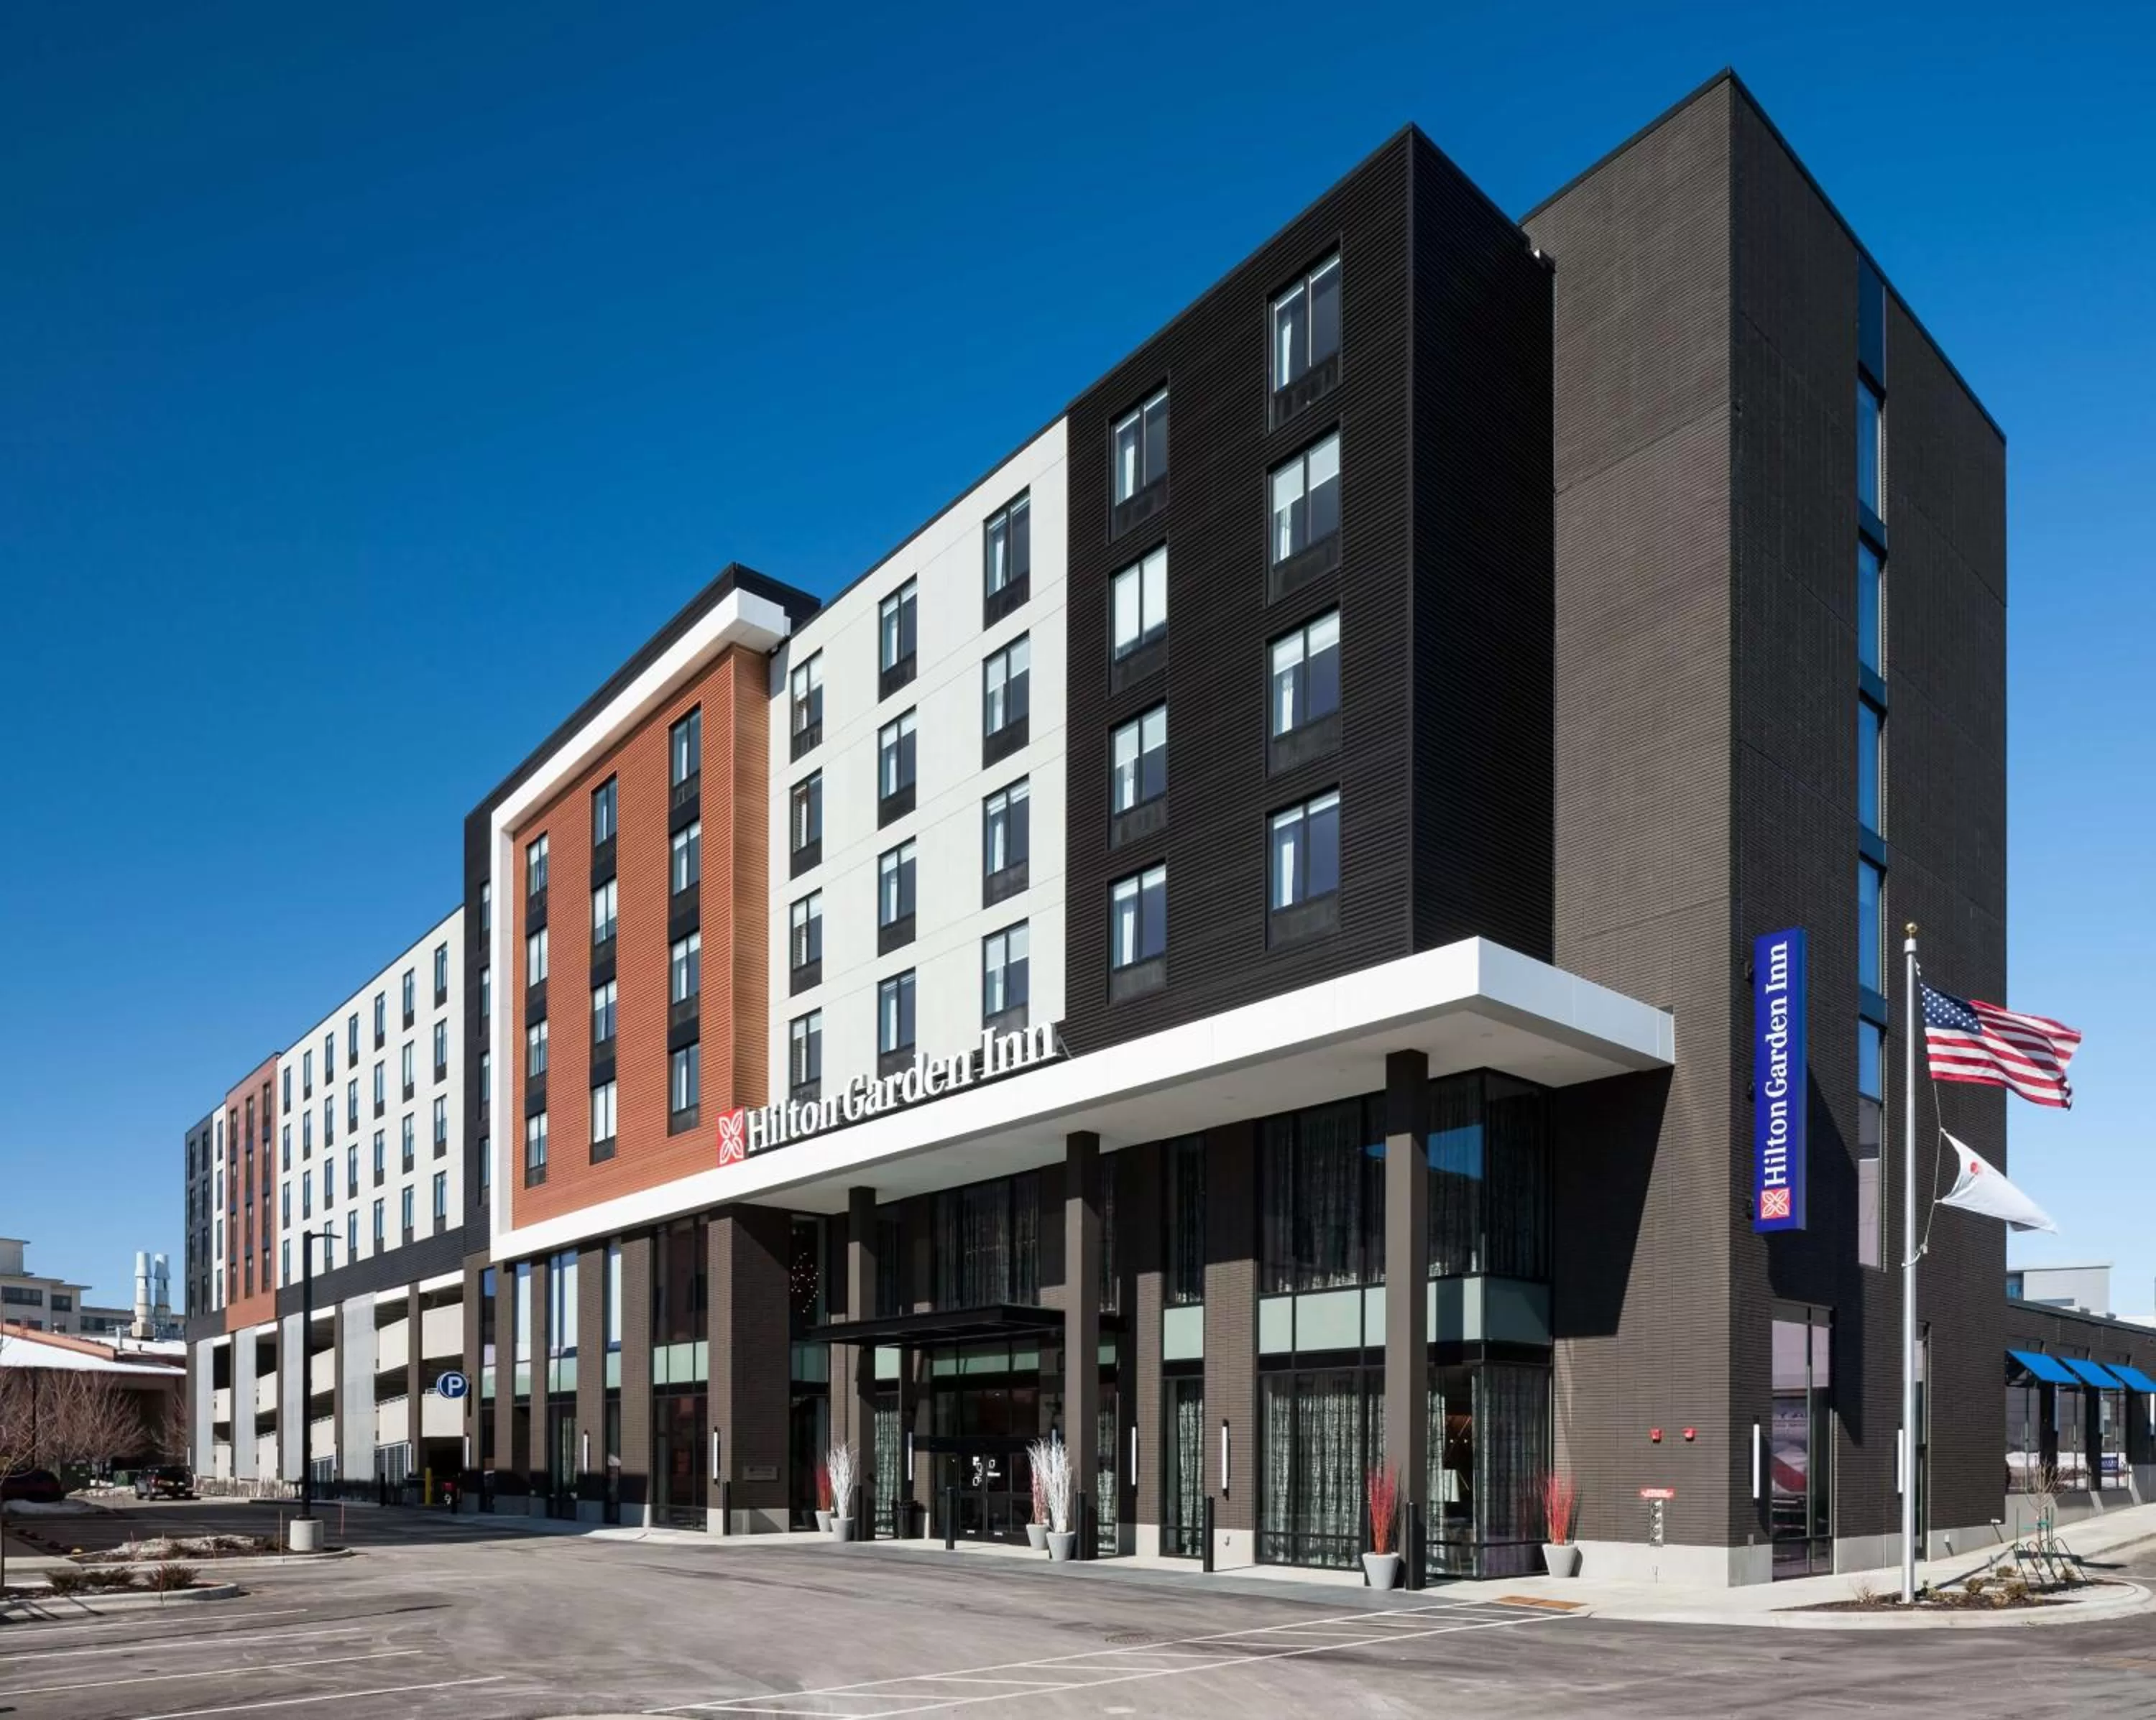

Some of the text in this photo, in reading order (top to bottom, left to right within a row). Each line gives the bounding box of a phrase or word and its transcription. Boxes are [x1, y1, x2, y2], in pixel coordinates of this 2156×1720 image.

[747, 1021, 1058, 1152] Hilton Garden Inn
[1764, 940, 1788, 1187] Hilton Garden Inn
[447, 1376, 464, 1395] P
